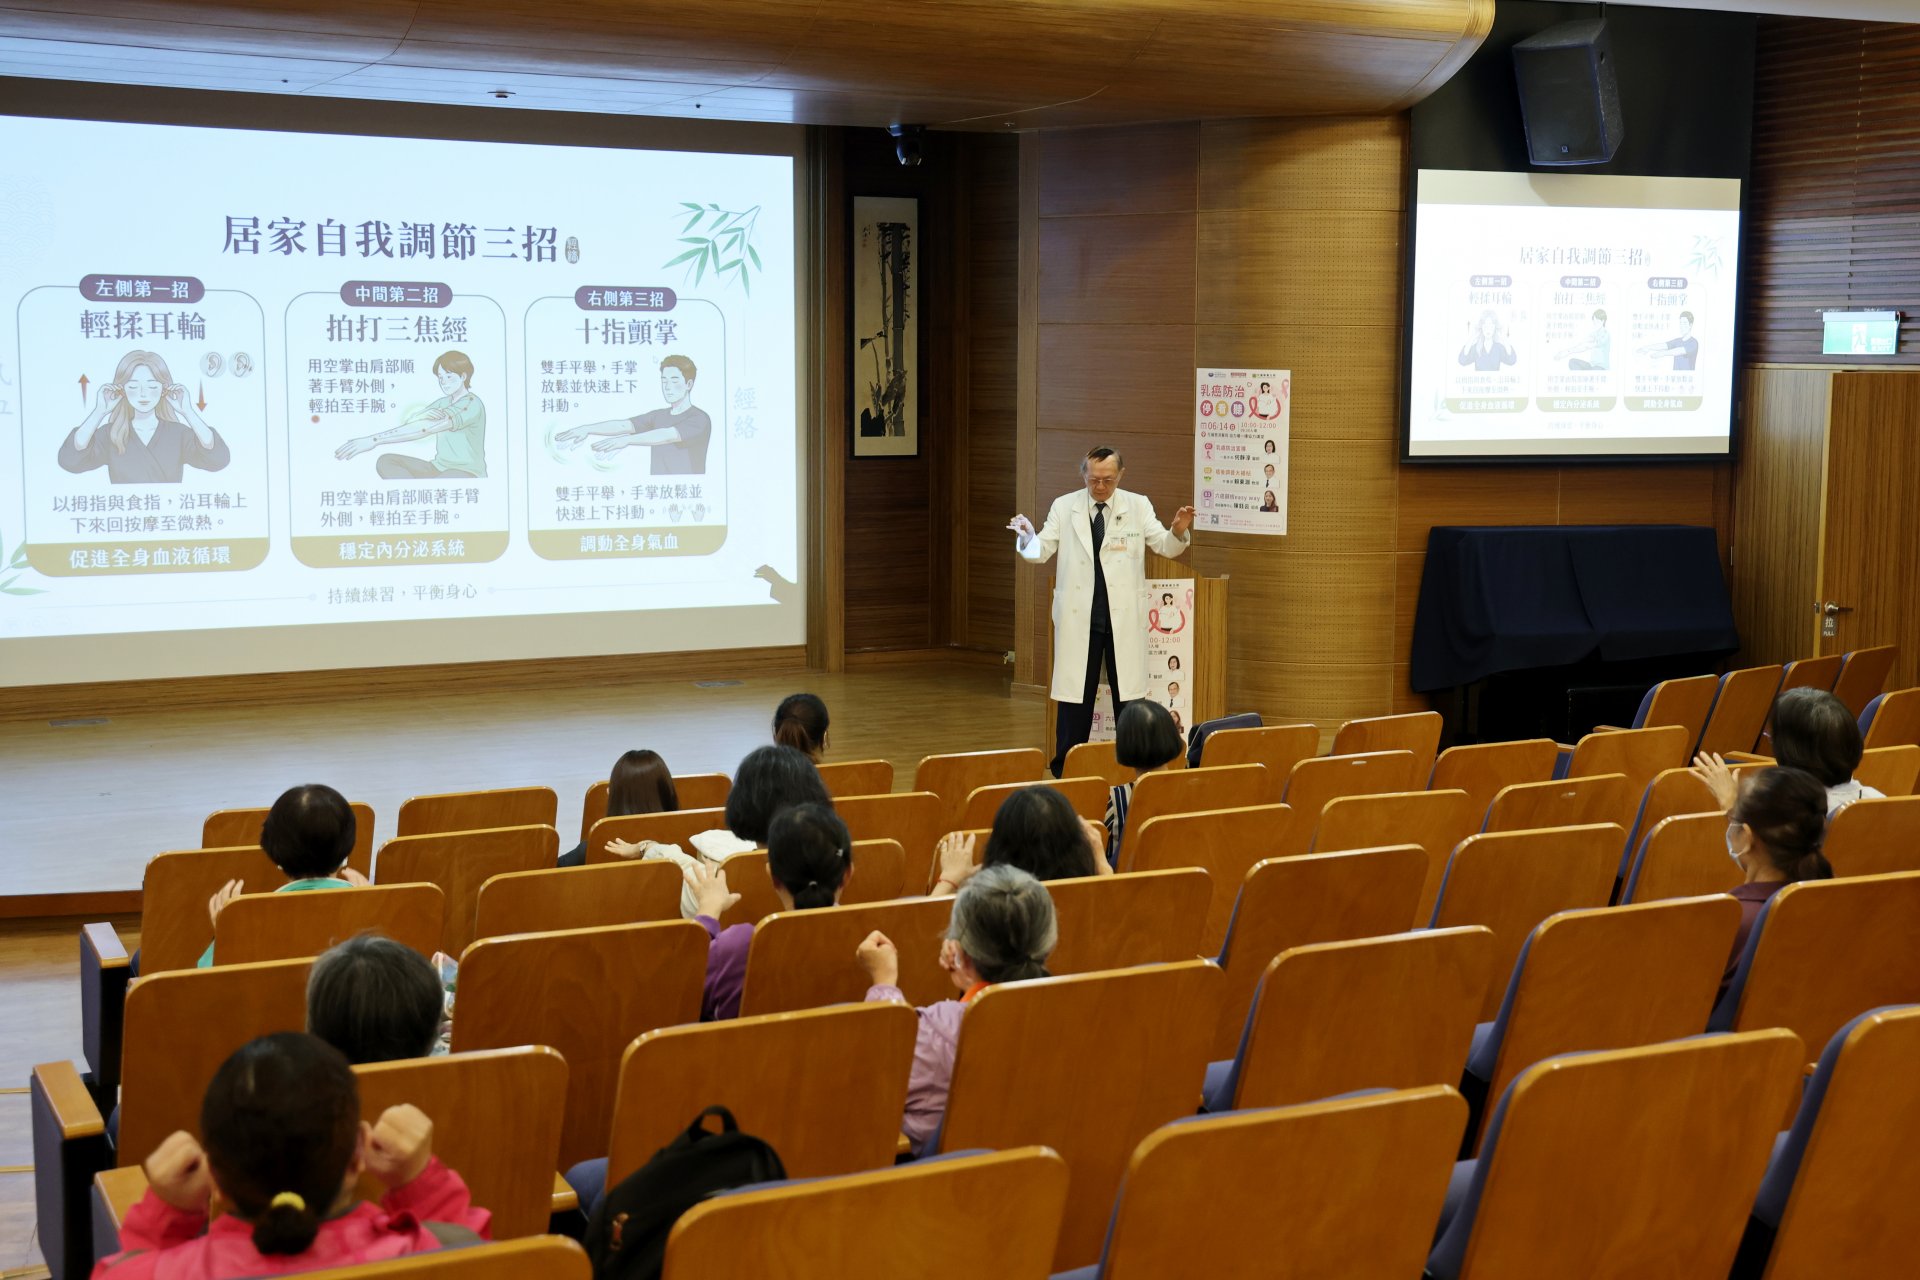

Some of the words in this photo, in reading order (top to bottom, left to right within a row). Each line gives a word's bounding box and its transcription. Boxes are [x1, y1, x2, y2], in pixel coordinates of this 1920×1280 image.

[222, 214, 558, 263] 居家自我調節三招
[1519, 246, 1643, 266] 居家自我調節三招
[95, 279, 190, 299] 左側第一招
[355, 285, 439, 304] 中間第二招
[588, 290, 664, 308] 右側第三招
[80, 309, 206, 341] 輕揉耳輪
[326, 314, 468, 343] 拍打三焦經
[575, 317, 678, 346] 十指顫掌
[307, 358, 415, 374] 用空掌由肩部順
[540, 359, 638, 375] 雙手平舉，手掌
[308, 378, 396, 394] 著手臂外側，
[540, 379, 638, 394] 放鬆並快速上下
[1200, 384, 1244, 397] 乳癌防治
[309, 398, 397, 414] 輕拍至手腕。
[541, 398, 580, 413] 抖動。
[52, 492, 248, 513] 以拇指與食指，沿耳輪上
[319, 488, 480, 508] 用空掌由肩部順著手臂
[555, 484, 702, 502] 雙手平舉，手掌放鬆並
[320, 509, 461, 528] 外側，輕拍至手腕。
[555, 504, 656, 521] 快速上下抖動。
[70, 515, 225, 534] 下來回按摩至微熱。
[338, 539, 465, 561] 穩定內分泌系統
[580, 533, 679, 553] 調動全身氣血
[70, 546, 232, 570] 促進全身血液循環
[328, 583, 477, 605] 持續練習，平衡身心
